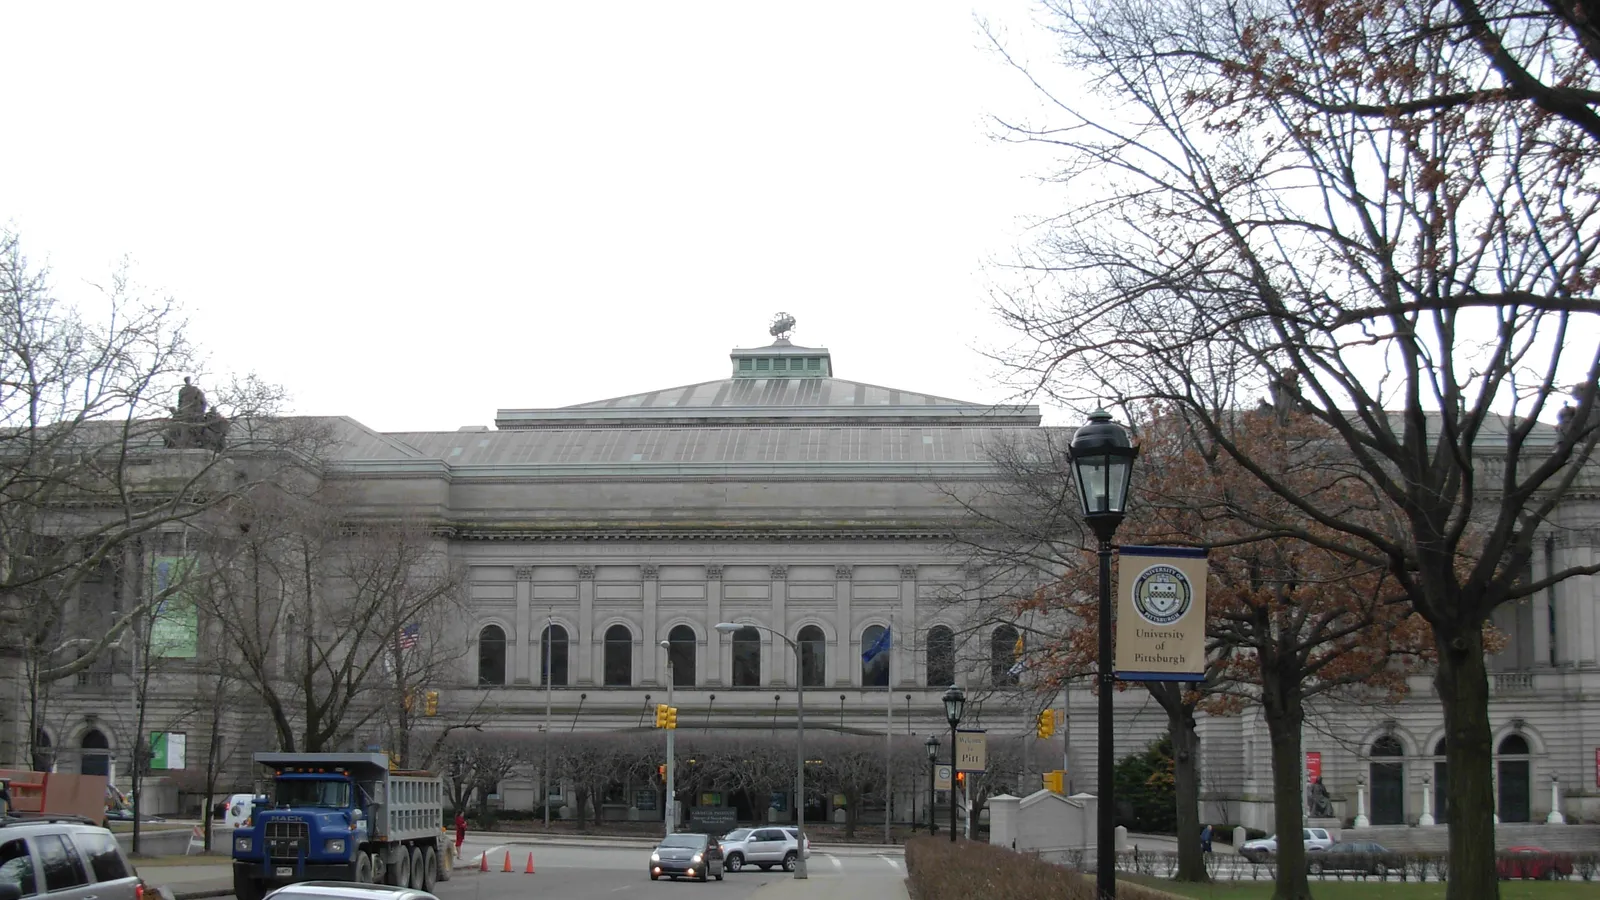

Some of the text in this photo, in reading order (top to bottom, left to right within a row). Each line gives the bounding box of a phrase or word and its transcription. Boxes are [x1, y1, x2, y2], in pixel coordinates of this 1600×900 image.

[1142, 567, 1184, 581] UNIVERSITY OF
[1144, 612, 1180, 623] PITTSBURGH
[1136, 629, 1185, 640] University
[1155, 641, 1165, 650] of
[1135, 653, 1185, 664] Pittsburgh
[962, 754, 979, 762] Pitt
